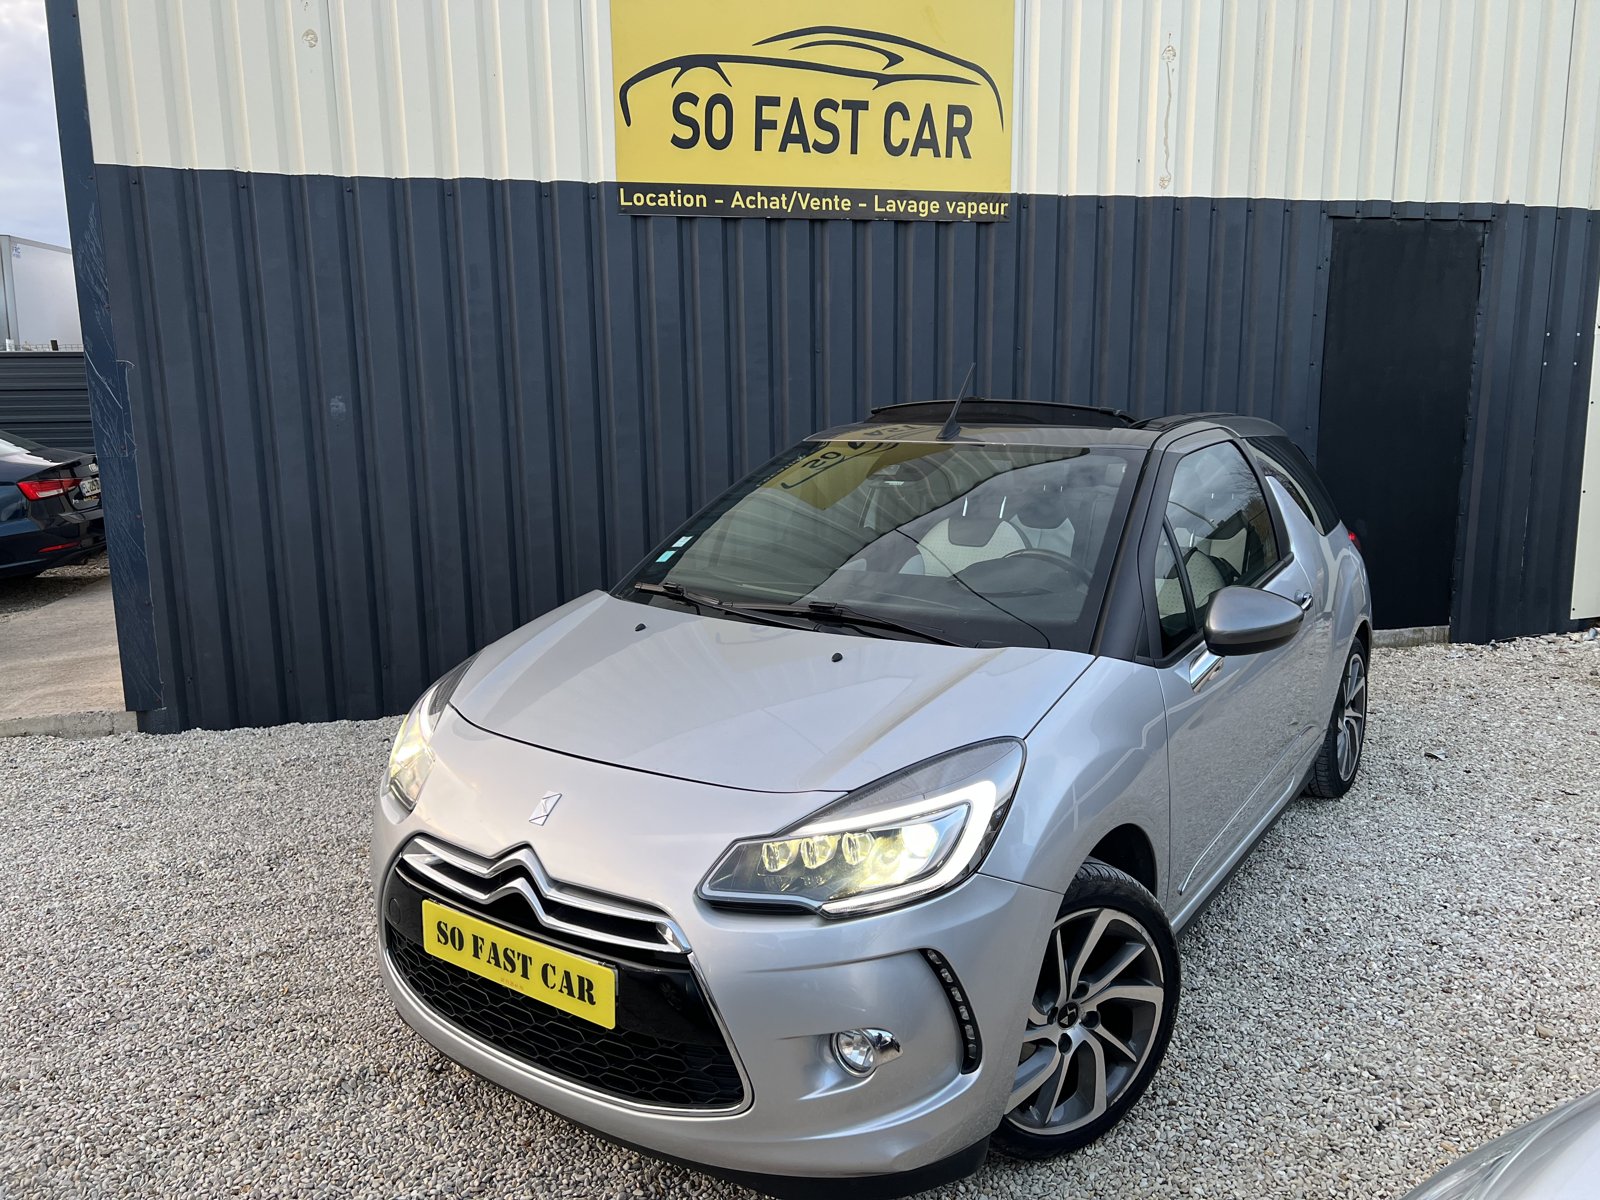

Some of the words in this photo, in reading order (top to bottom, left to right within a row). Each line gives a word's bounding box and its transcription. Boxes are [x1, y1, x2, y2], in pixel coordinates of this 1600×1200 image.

[670, 91, 734, 151] SO
[754, 95, 869, 155] FAST
[883, 101, 973, 159] CAR
[620, 187, 707, 208] Location
[730, 191, 851, 212] Achat/Vente
[874, 194, 940, 218] Lavage
[945, 201, 1009, 218] vapeur
[436, 920, 464, 952] SO
[471, 933, 533, 980] FAST
[541, 962, 597, 1006] CAR
